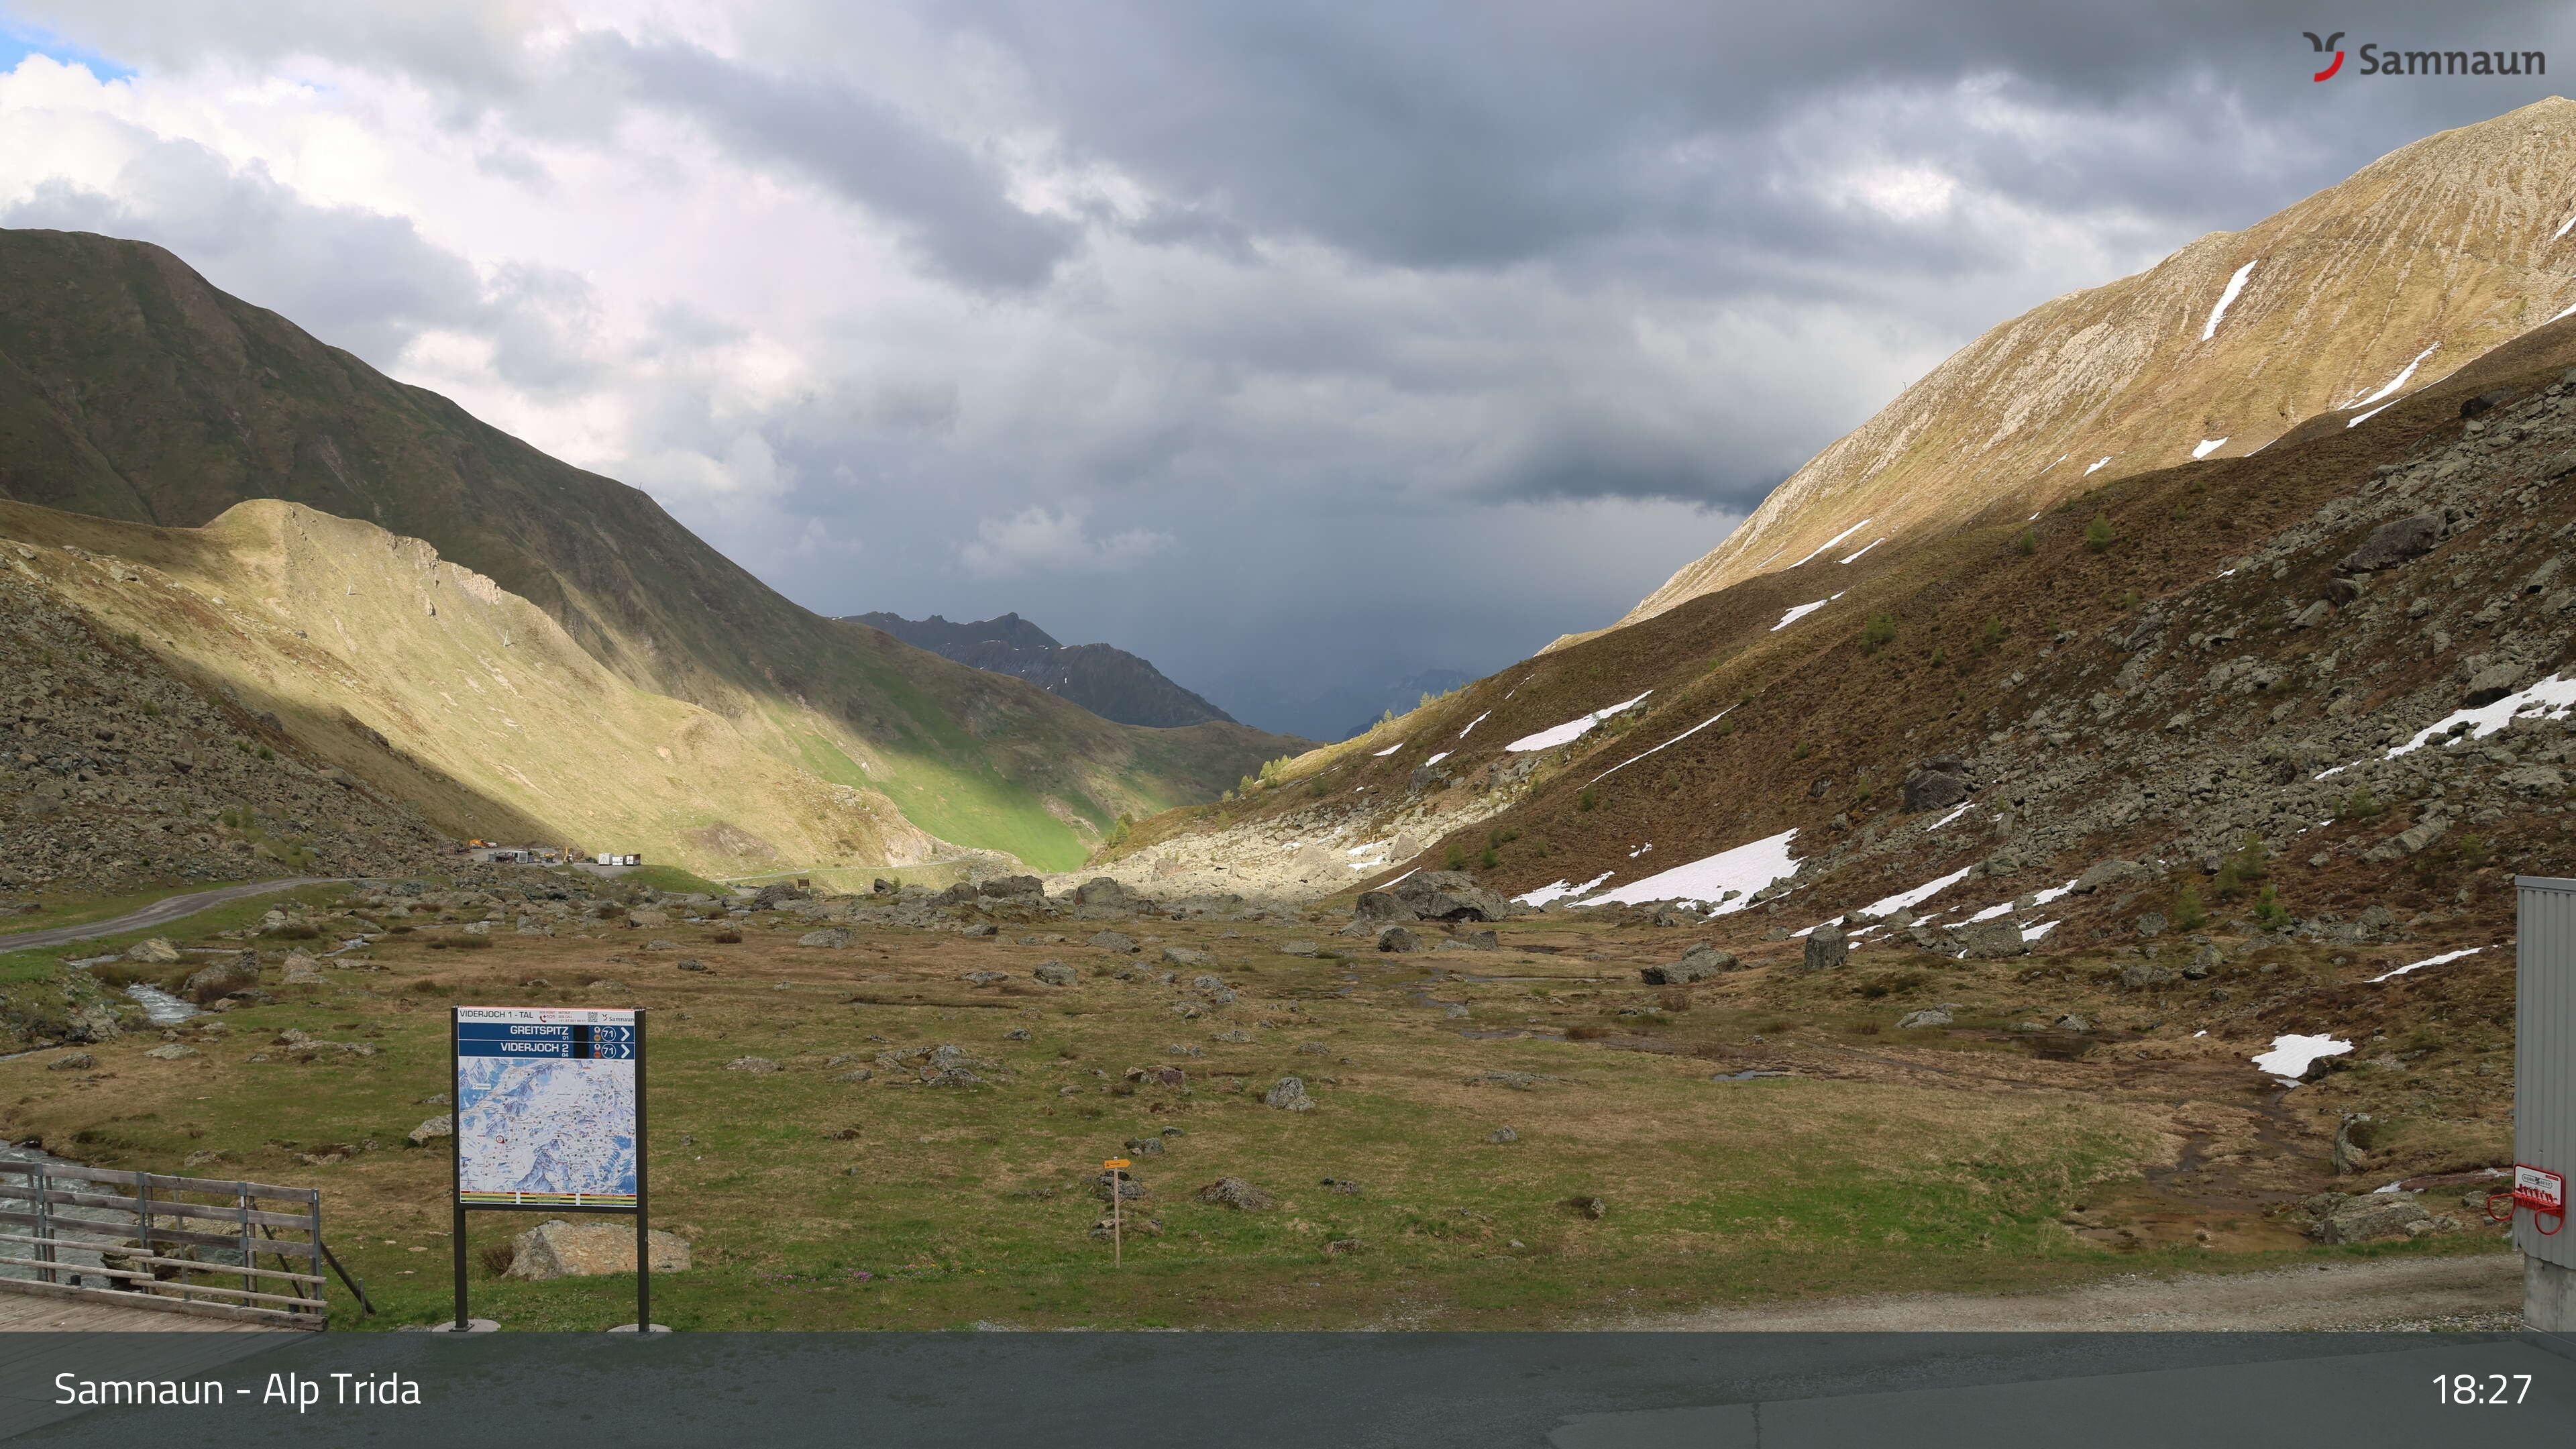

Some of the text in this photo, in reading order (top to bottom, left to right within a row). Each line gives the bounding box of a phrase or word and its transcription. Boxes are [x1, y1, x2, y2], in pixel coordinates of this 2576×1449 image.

[510, 1025, 569, 1035] GREITSPITZ
[500, 1042, 569, 1053] VIDERJOCH 2
